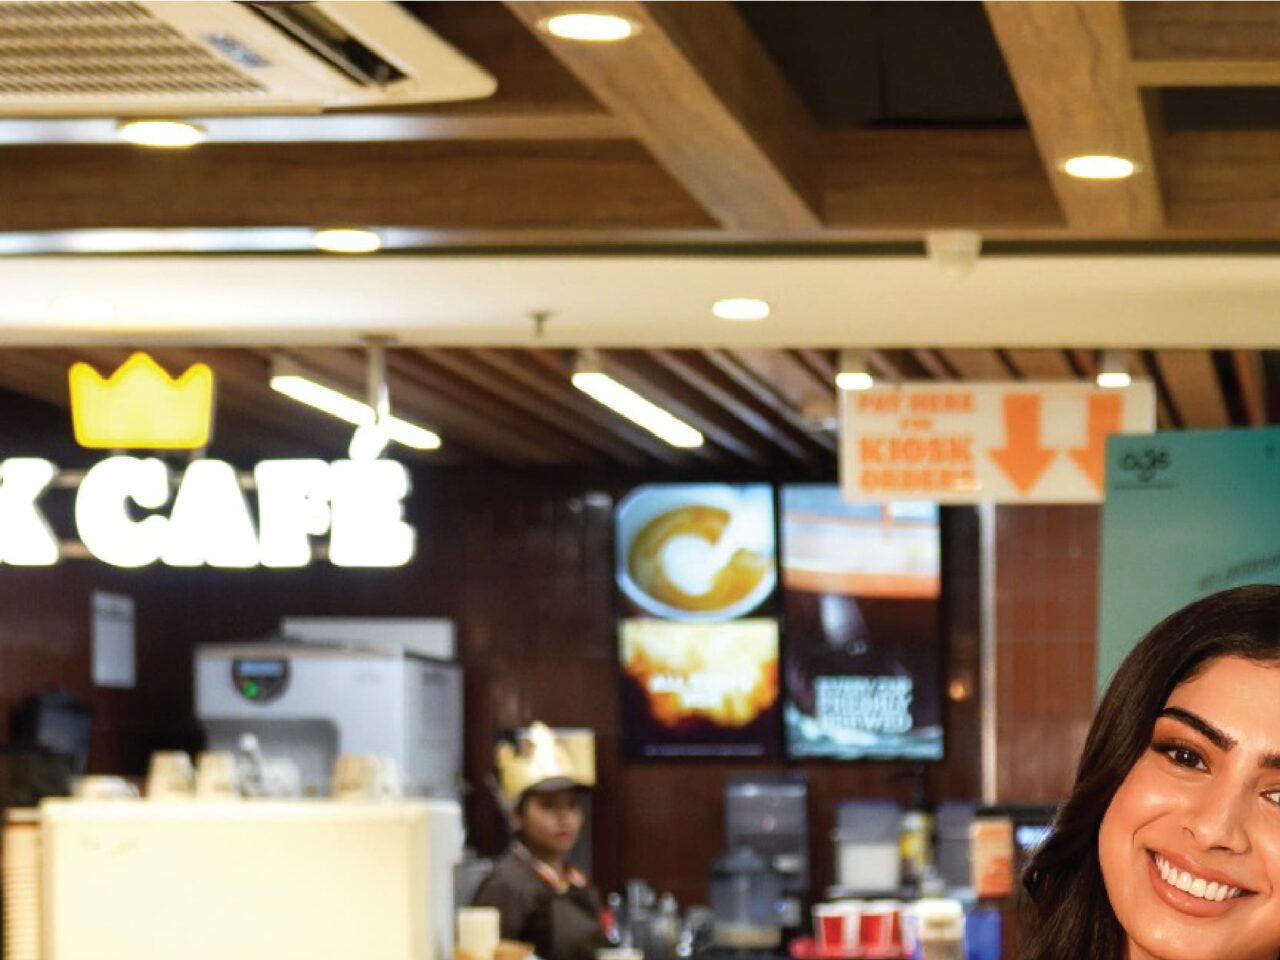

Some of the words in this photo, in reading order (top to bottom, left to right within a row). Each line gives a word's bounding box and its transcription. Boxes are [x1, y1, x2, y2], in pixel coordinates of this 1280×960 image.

[857, 394, 900, 413] PAY
[860, 437, 973, 465] KIOSK
[75, 420, 416, 568] CAFÉ
